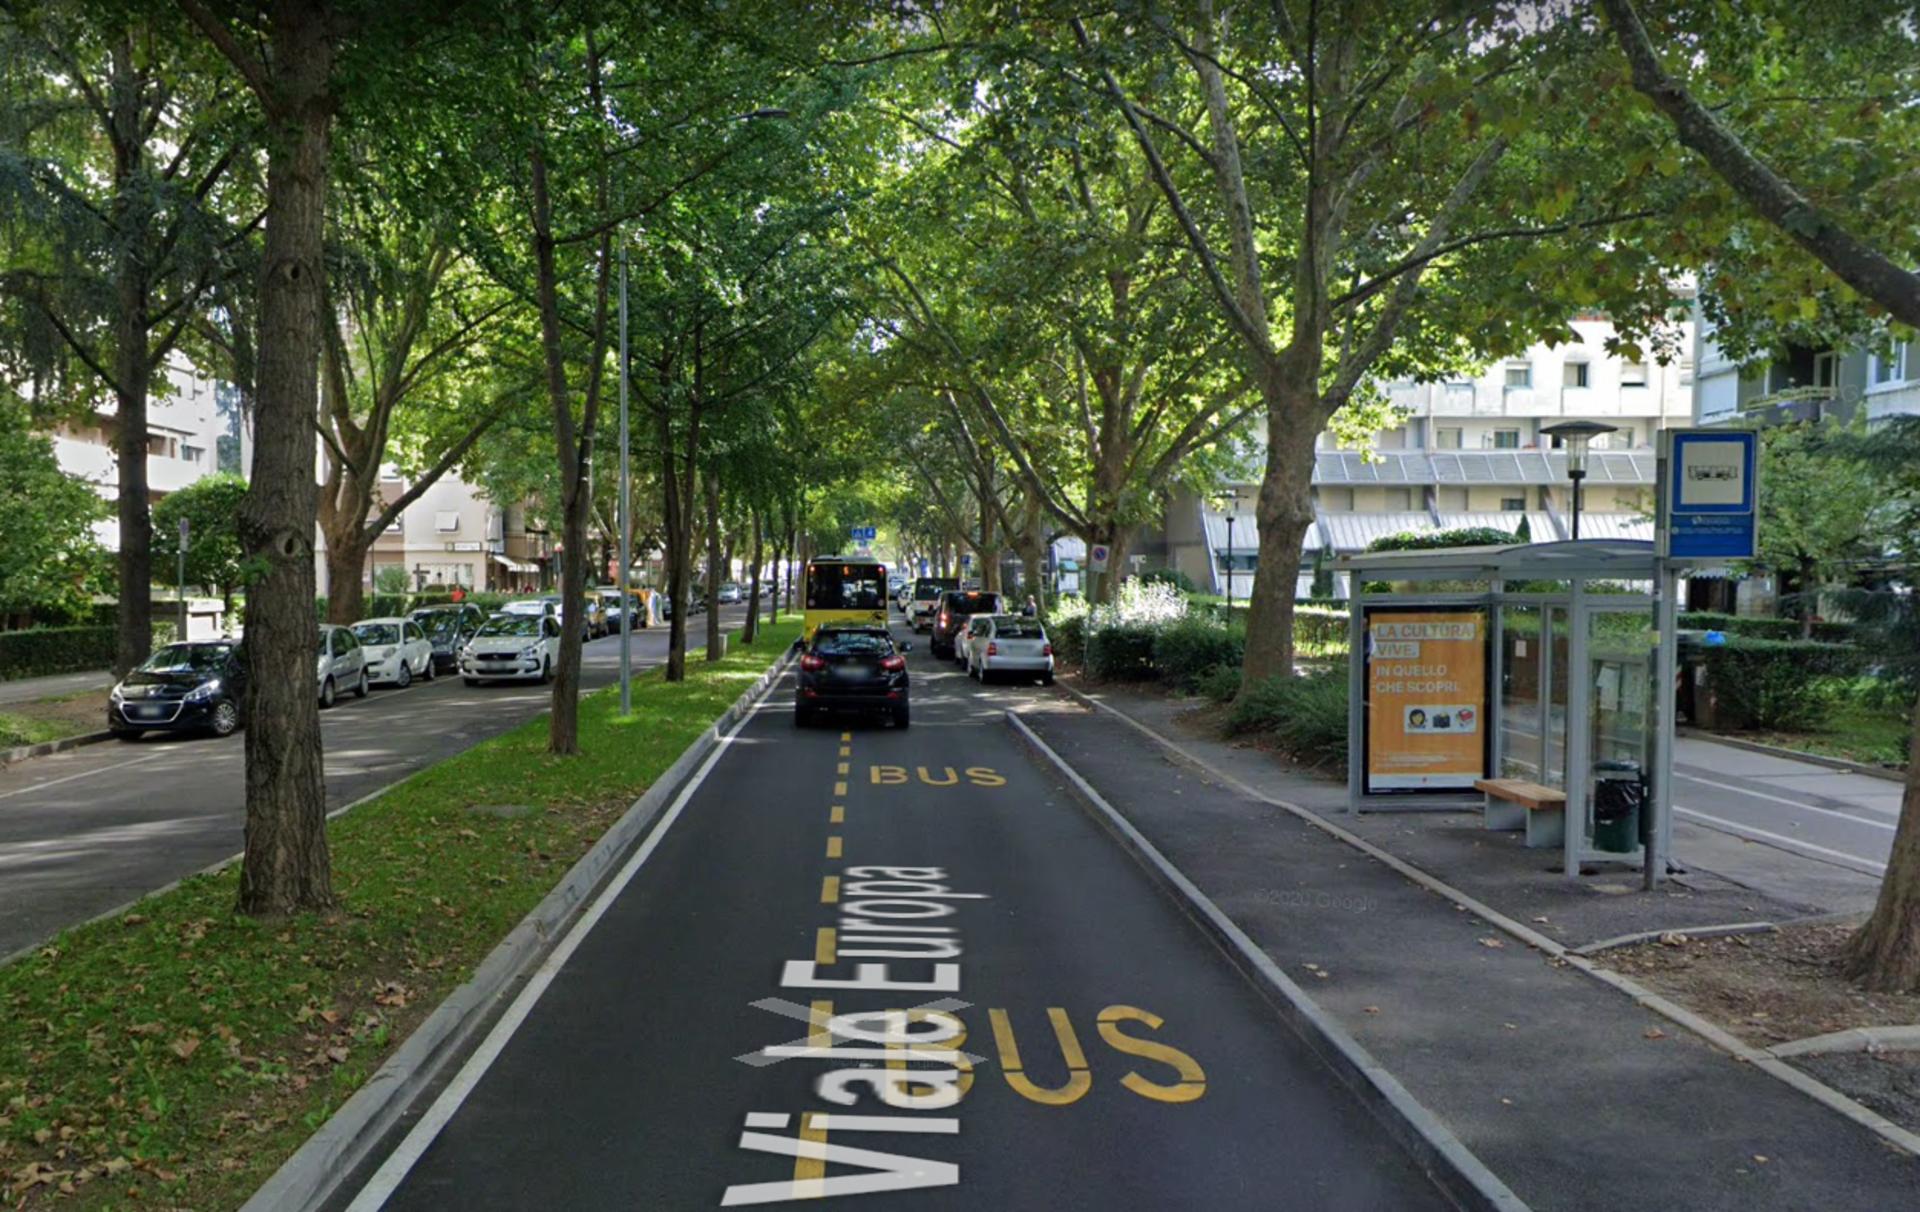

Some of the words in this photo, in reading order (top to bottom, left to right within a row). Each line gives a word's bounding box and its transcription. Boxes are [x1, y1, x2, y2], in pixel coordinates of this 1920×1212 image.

[1377, 625, 1397, 638] LA
[1401, 624, 1472, 638] CULTURA
[1376, 643, 1417, 657] VIVE.
[1376, 664, 1390, 677] IN
[1393, 663, 1448, 677] QUELLO
[1376, 681, 1405, 694] CHE
[870, 765, 1007, 786] BUS
[885, 1004, 1207, 1106] BUS
